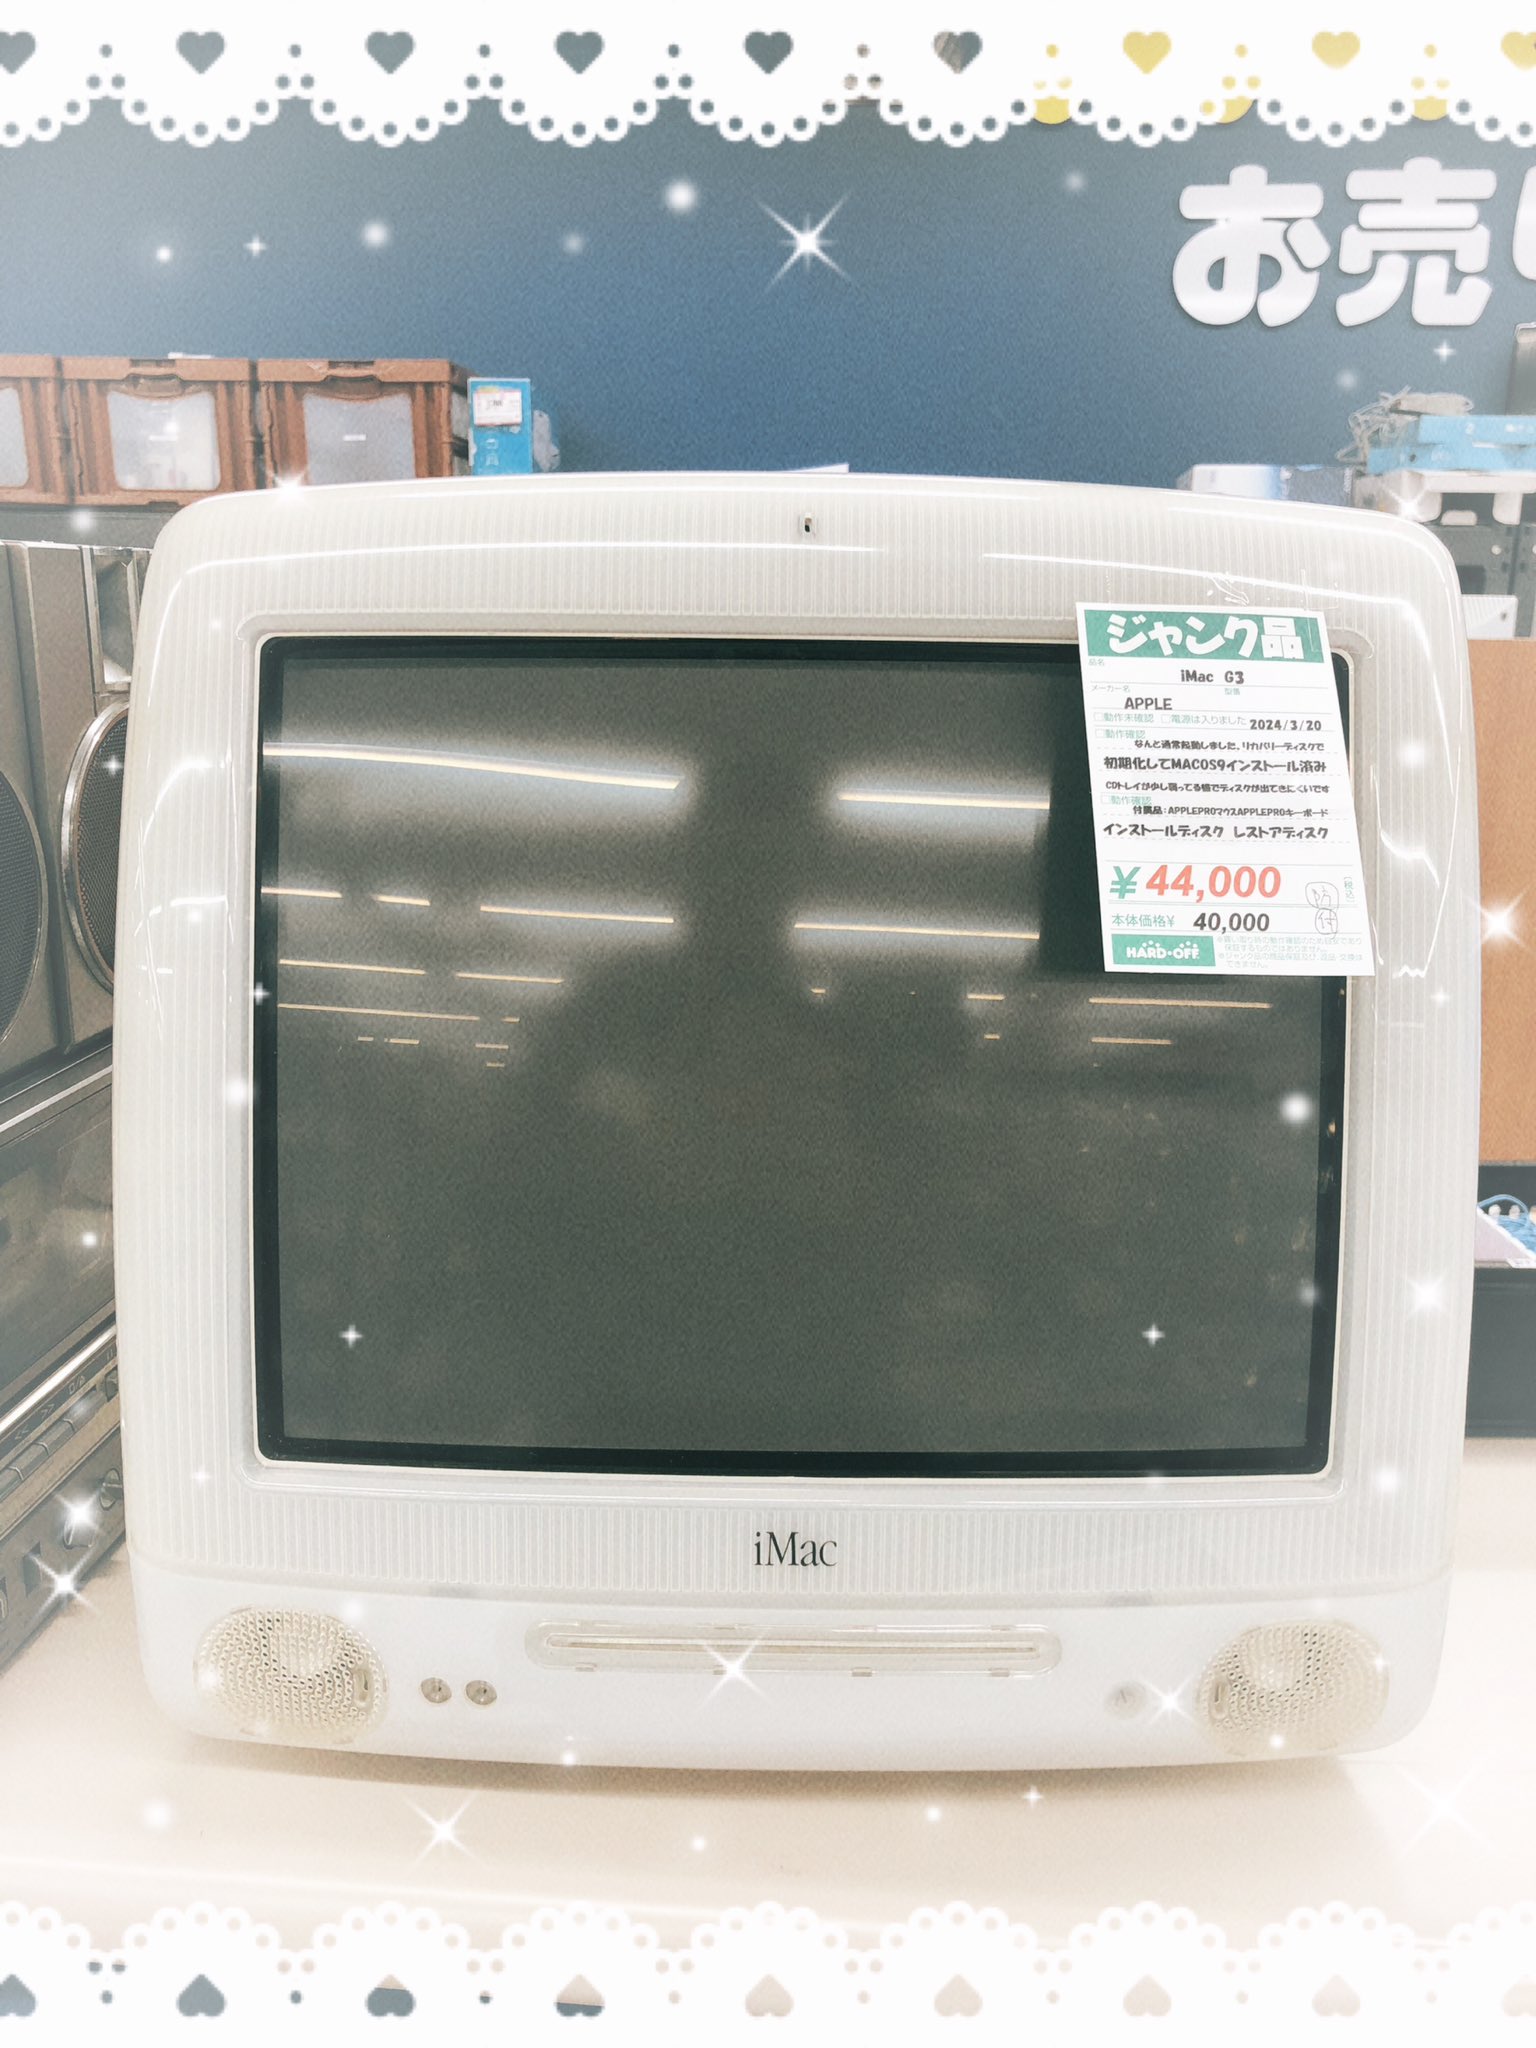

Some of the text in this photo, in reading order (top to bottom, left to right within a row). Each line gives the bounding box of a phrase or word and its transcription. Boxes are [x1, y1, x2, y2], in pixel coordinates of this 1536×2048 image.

[1173, 156, 1536, 327] お売
[1107, 613, 1304, 660] ジャンク品
[1181, 669, 1244, 684] iMac G3
[1124, 698, 1173, 711] APPLE
[1250, 719, 1322, 731] 2024/3/20
[1103, 756, 1327, 773] 初期化してMACOS9インストール済み
[1103, 823, 1329, 840] インストールディスク レストアディスク
[1193, 912, 1270, 934] 40,000
[754, 1531, 838, 1567] iMac
